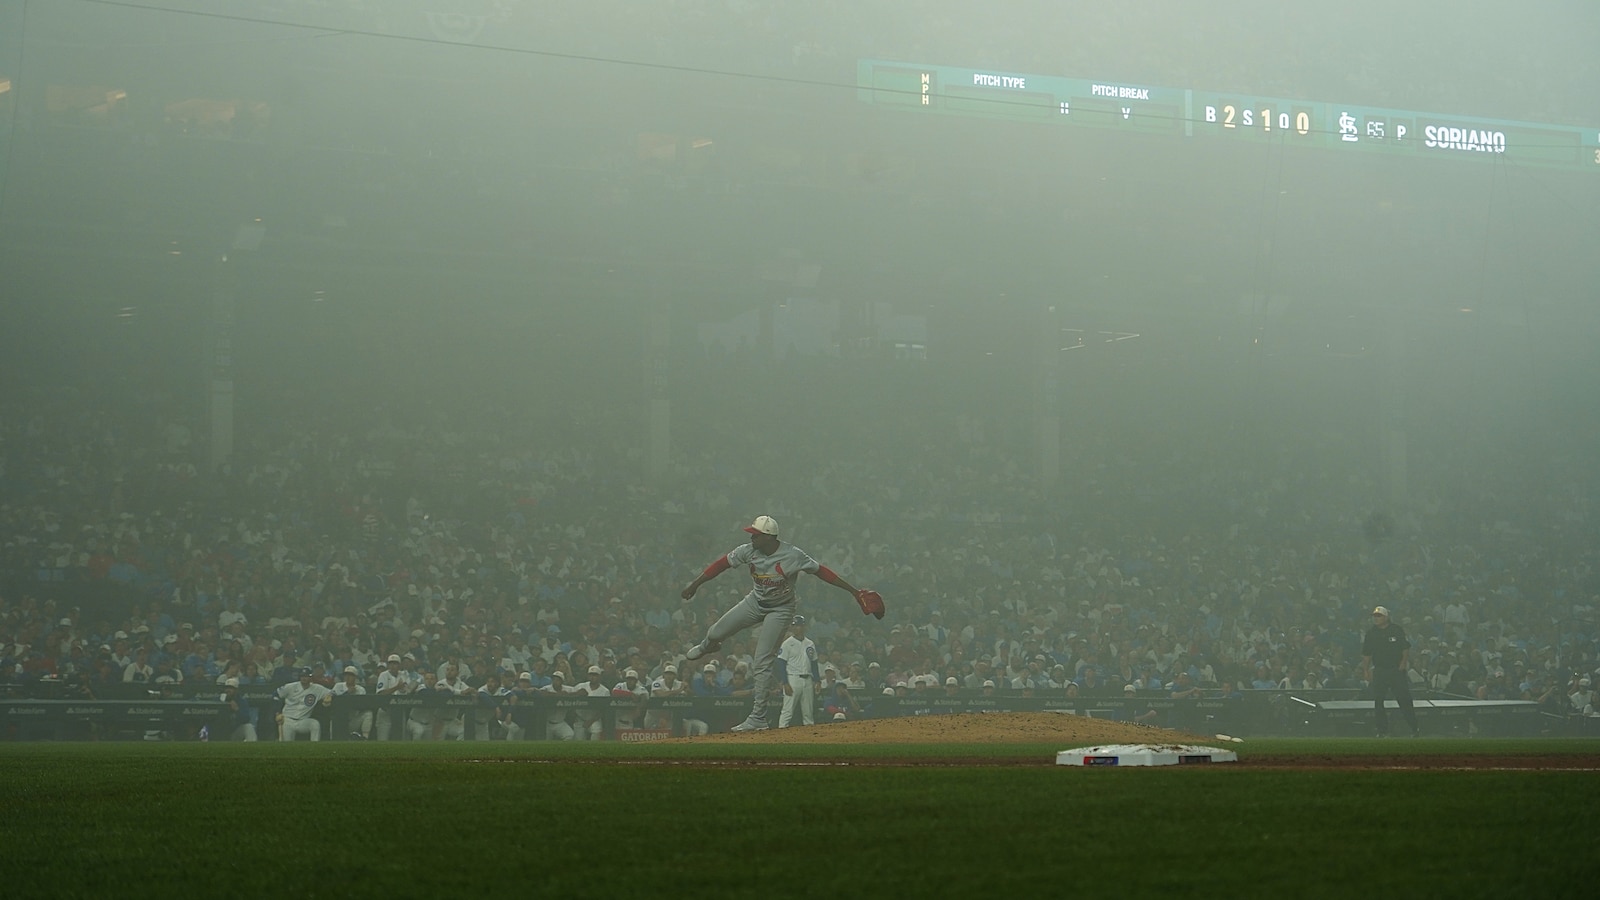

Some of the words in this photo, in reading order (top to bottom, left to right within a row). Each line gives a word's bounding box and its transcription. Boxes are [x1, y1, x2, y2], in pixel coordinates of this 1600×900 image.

[921, 73, 930, 105] MPH
[973, 73, 1001, 87] PITCH
[1001, 76, 1026, 89] TYPE
[1091, 84, 1118, 97] PITCH
[1119, 87, 1149, 100] BREAK
[1205, 105, 1217, 122] B
[1223, 105, 1236, 128] 2
[1242, 109, 1253, 126] S
[1261, 109, 1271, 131] 1
[1366, 121, 1385, 140] 65
[1396, 124, 1407, 141] P
[1424, 125, 1506, 154] SORIANO
[621, 732, 669, 741] GATORADE
